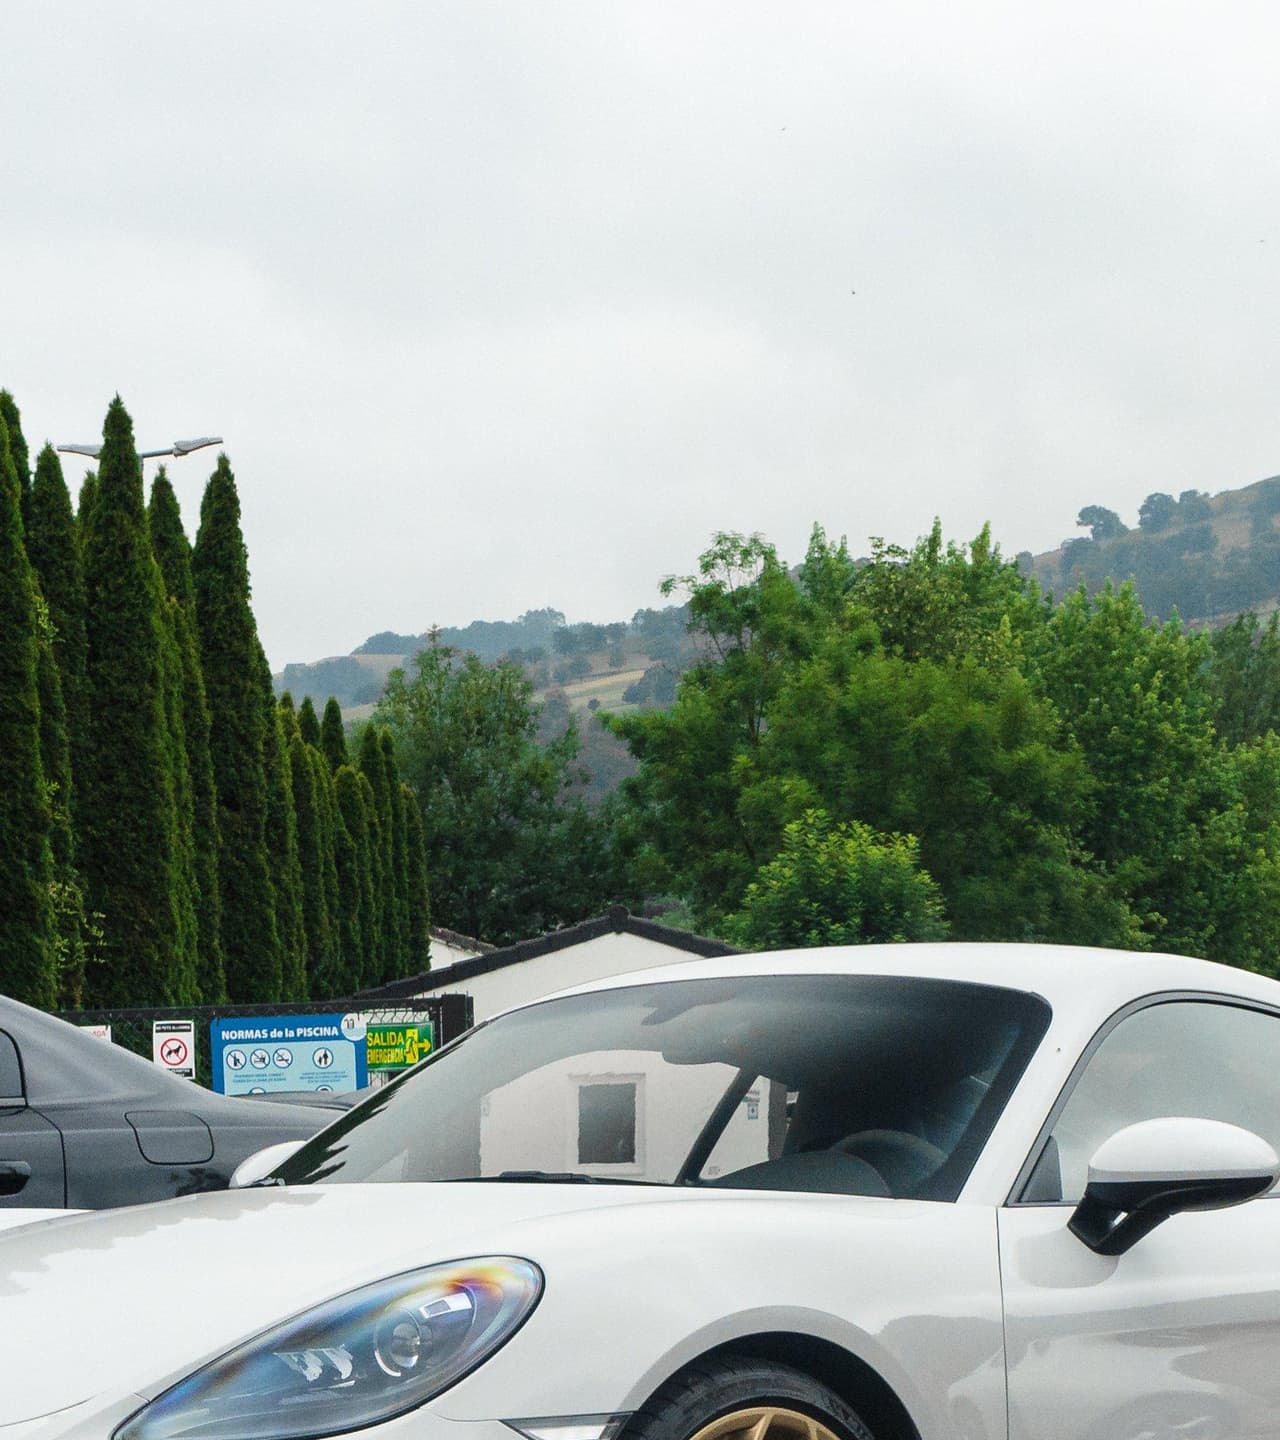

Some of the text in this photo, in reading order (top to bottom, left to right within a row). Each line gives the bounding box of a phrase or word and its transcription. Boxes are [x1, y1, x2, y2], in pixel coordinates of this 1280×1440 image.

[221, 1026, 339, 1040] NORMAS de la PISCINA
[367, 1031, 405, 1046] SALIDA
[367, 1048, 405, 1064] EMERGENCIA
